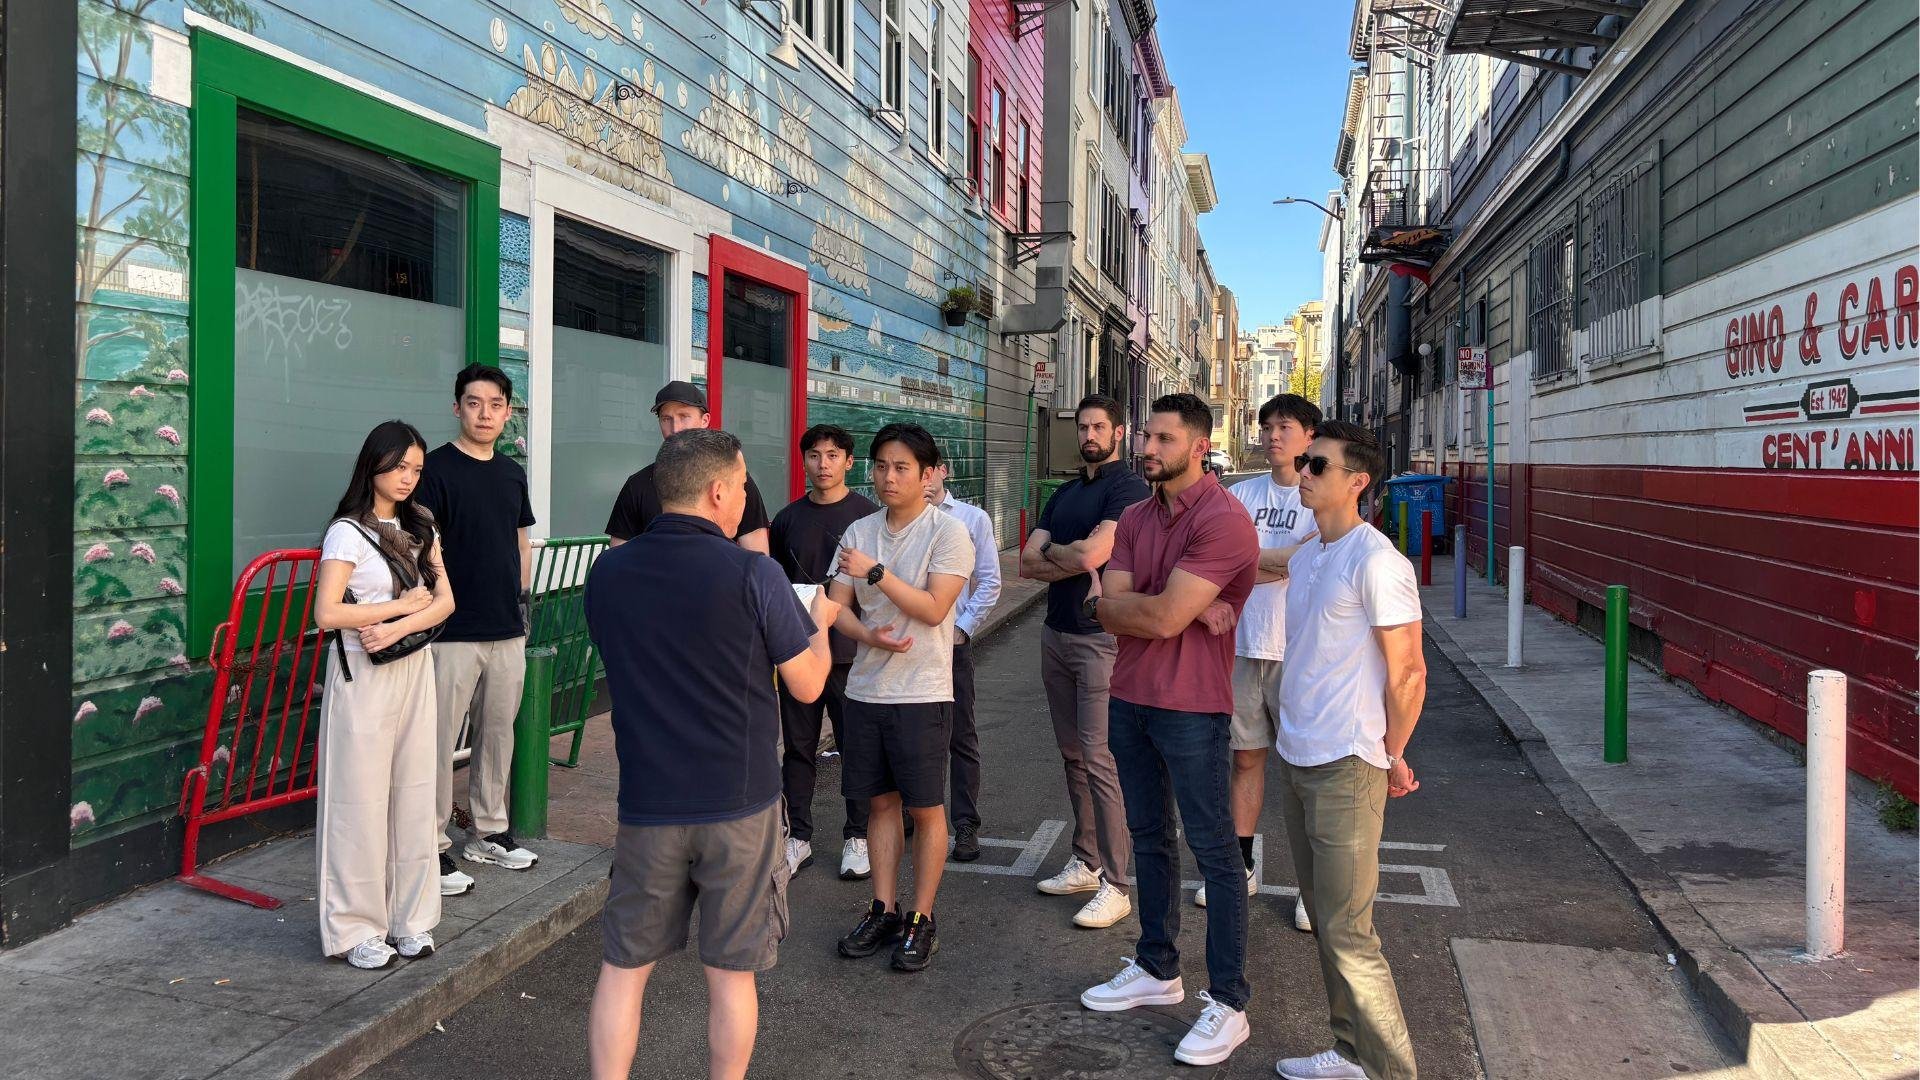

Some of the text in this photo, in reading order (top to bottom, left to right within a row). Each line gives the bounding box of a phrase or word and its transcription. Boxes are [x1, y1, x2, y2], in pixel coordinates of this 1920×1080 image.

[1725, 265, 1919, 379] GINO & CAR
[1460, 349, 1470, 358] NO
[1810, 387, 1847, 411] Est 1942
[1254, 507, 1297, 530] POLO
